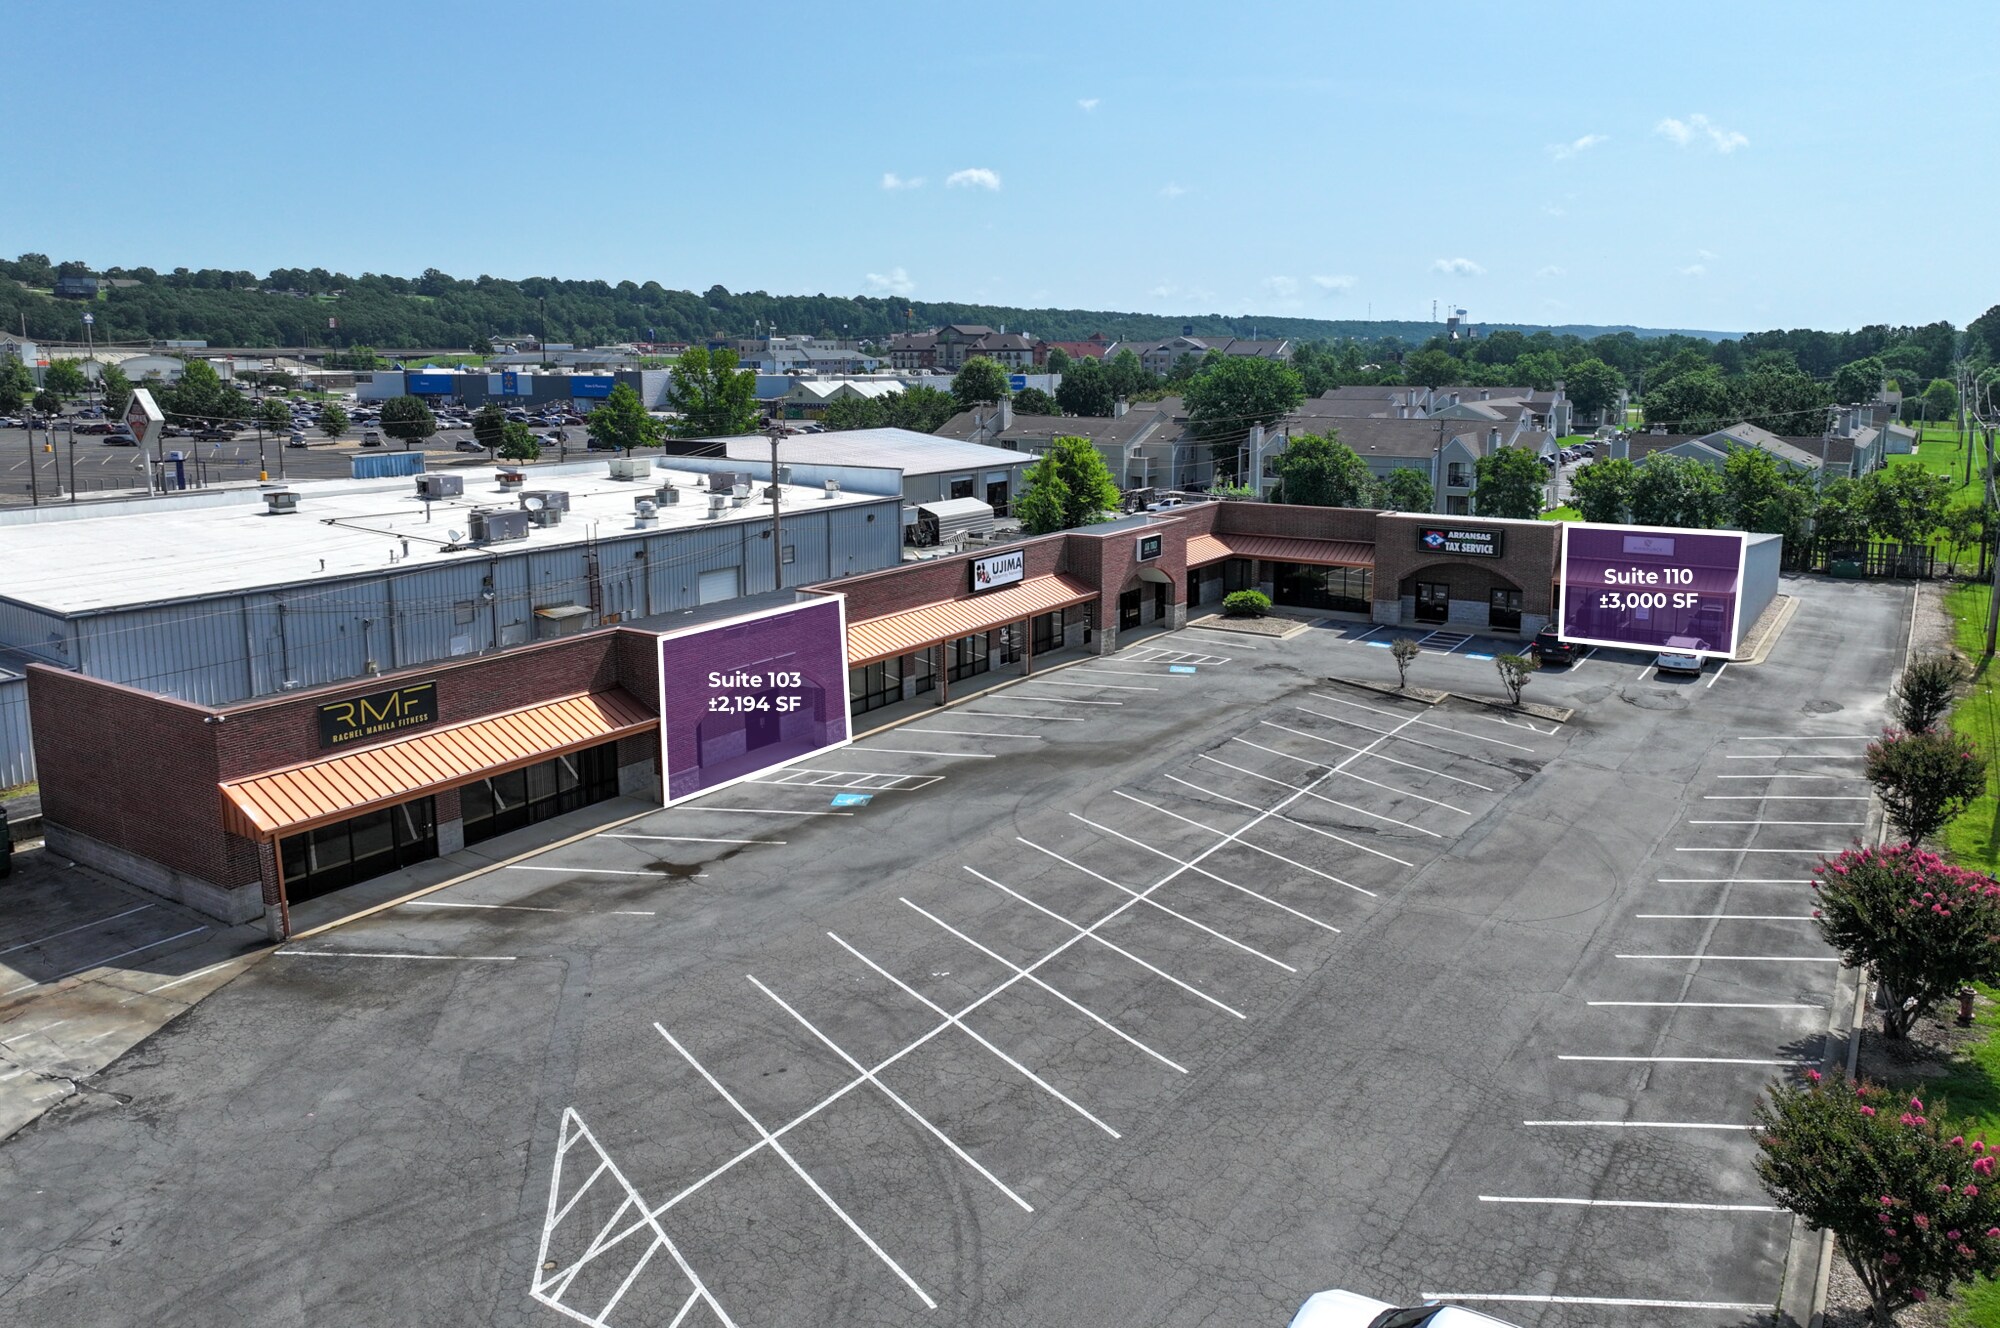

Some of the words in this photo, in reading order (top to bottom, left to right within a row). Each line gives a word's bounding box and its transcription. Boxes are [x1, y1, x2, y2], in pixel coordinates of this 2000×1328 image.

[1447, 531, 1491, 541] ARKANSAS
[1444, 542, 1460, 552] TAX
[1461, 543, 1493, 554] SERVICE
[992, 556, 1022, 575] UJIMA
[323, 684, 432, 728] RMF
[332, 731, 364, 743] RACHEL
[366, 721, 396, 735] MANILA
[398, 713, 429, 727] FITNESS
